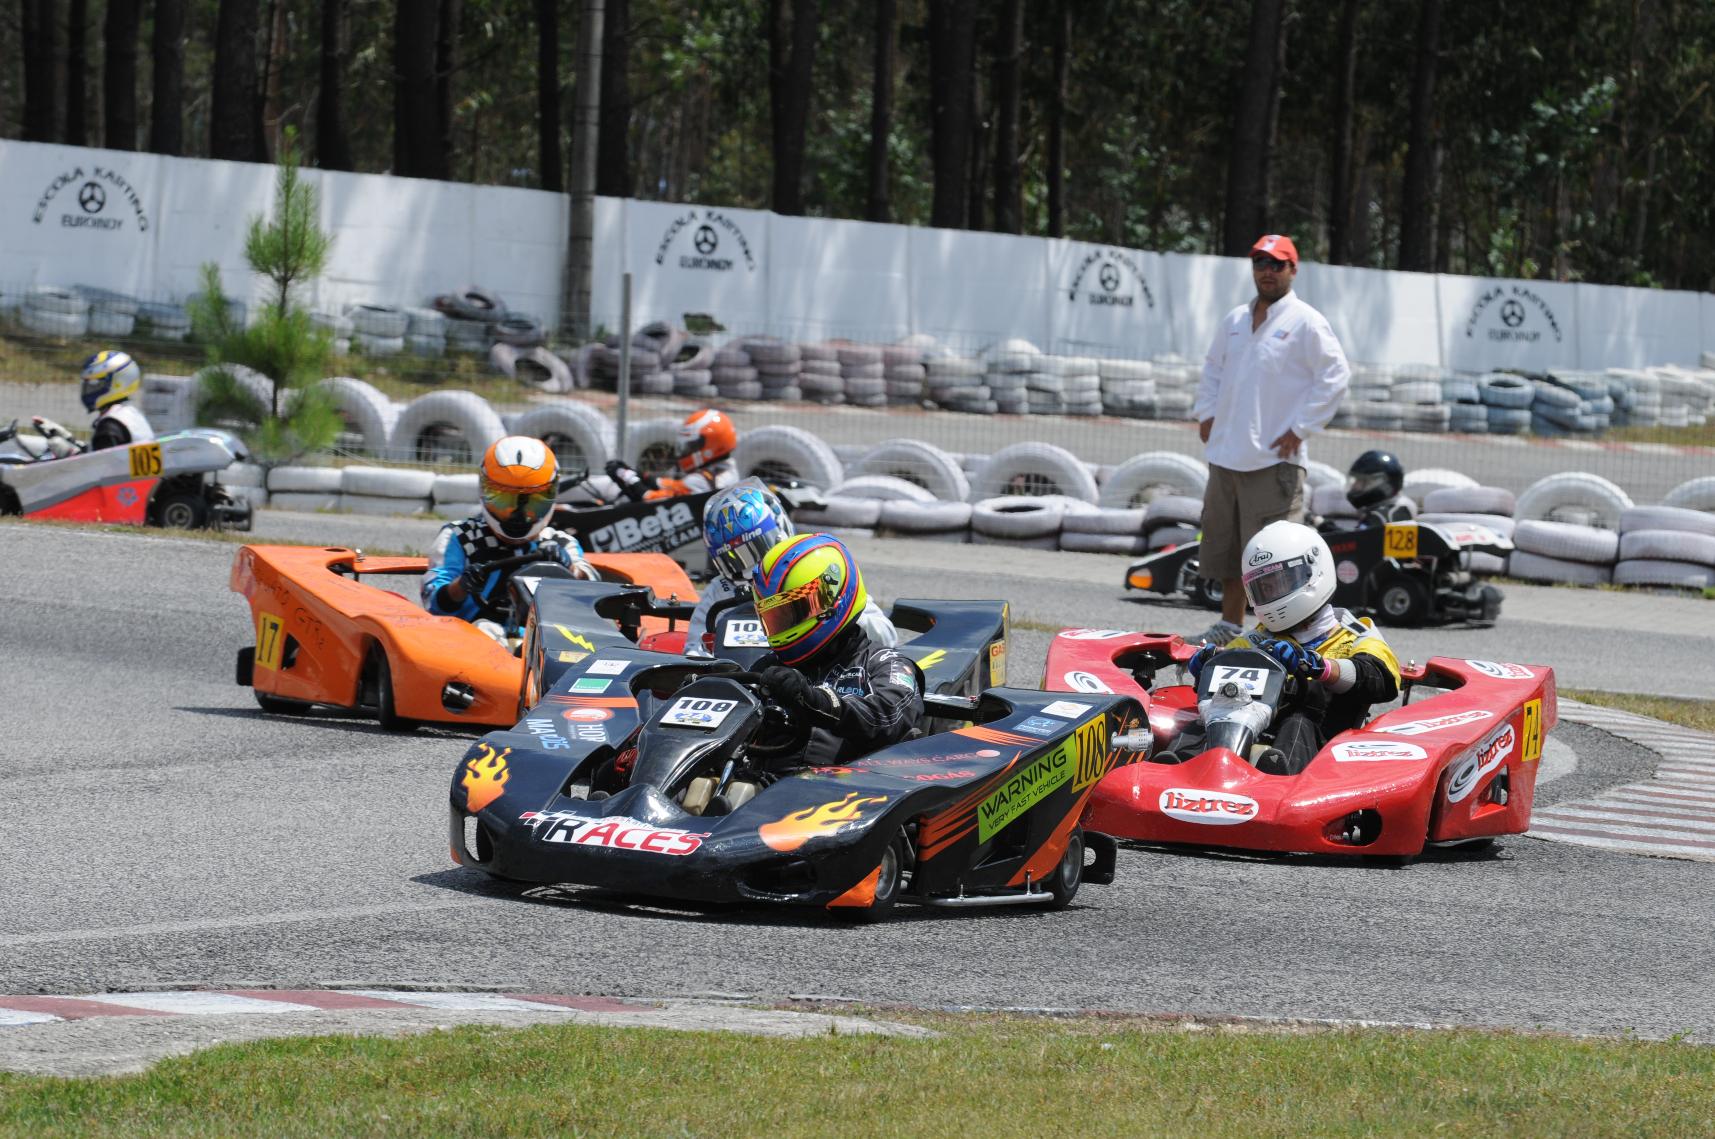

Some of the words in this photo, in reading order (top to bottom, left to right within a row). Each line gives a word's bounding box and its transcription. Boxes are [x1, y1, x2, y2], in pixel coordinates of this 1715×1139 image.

[94, 167, 149, 232] KARTING
[130, 446, 162, 477] 105
[615, 503, 694, 549] Beta
[1387, 527, 1416, 553] 128
[257, 617, 280, 663] 17
[731, 622, 764, 633] 10
[1220, 667, 1260, 682] 74
[678, 699, 734, 713] 108
[577, 723, 607, 743] HOP
[1077, 719, 1106, 786] 108
[1524, 704, 1541, 759] 74
[981, 747, 1067, 820] WARNING
[988, 809, 1010, 832] VERY
[1011, 796, 1032, 815] FAST
[1032, 770, 1067, 801] VEHICLE
